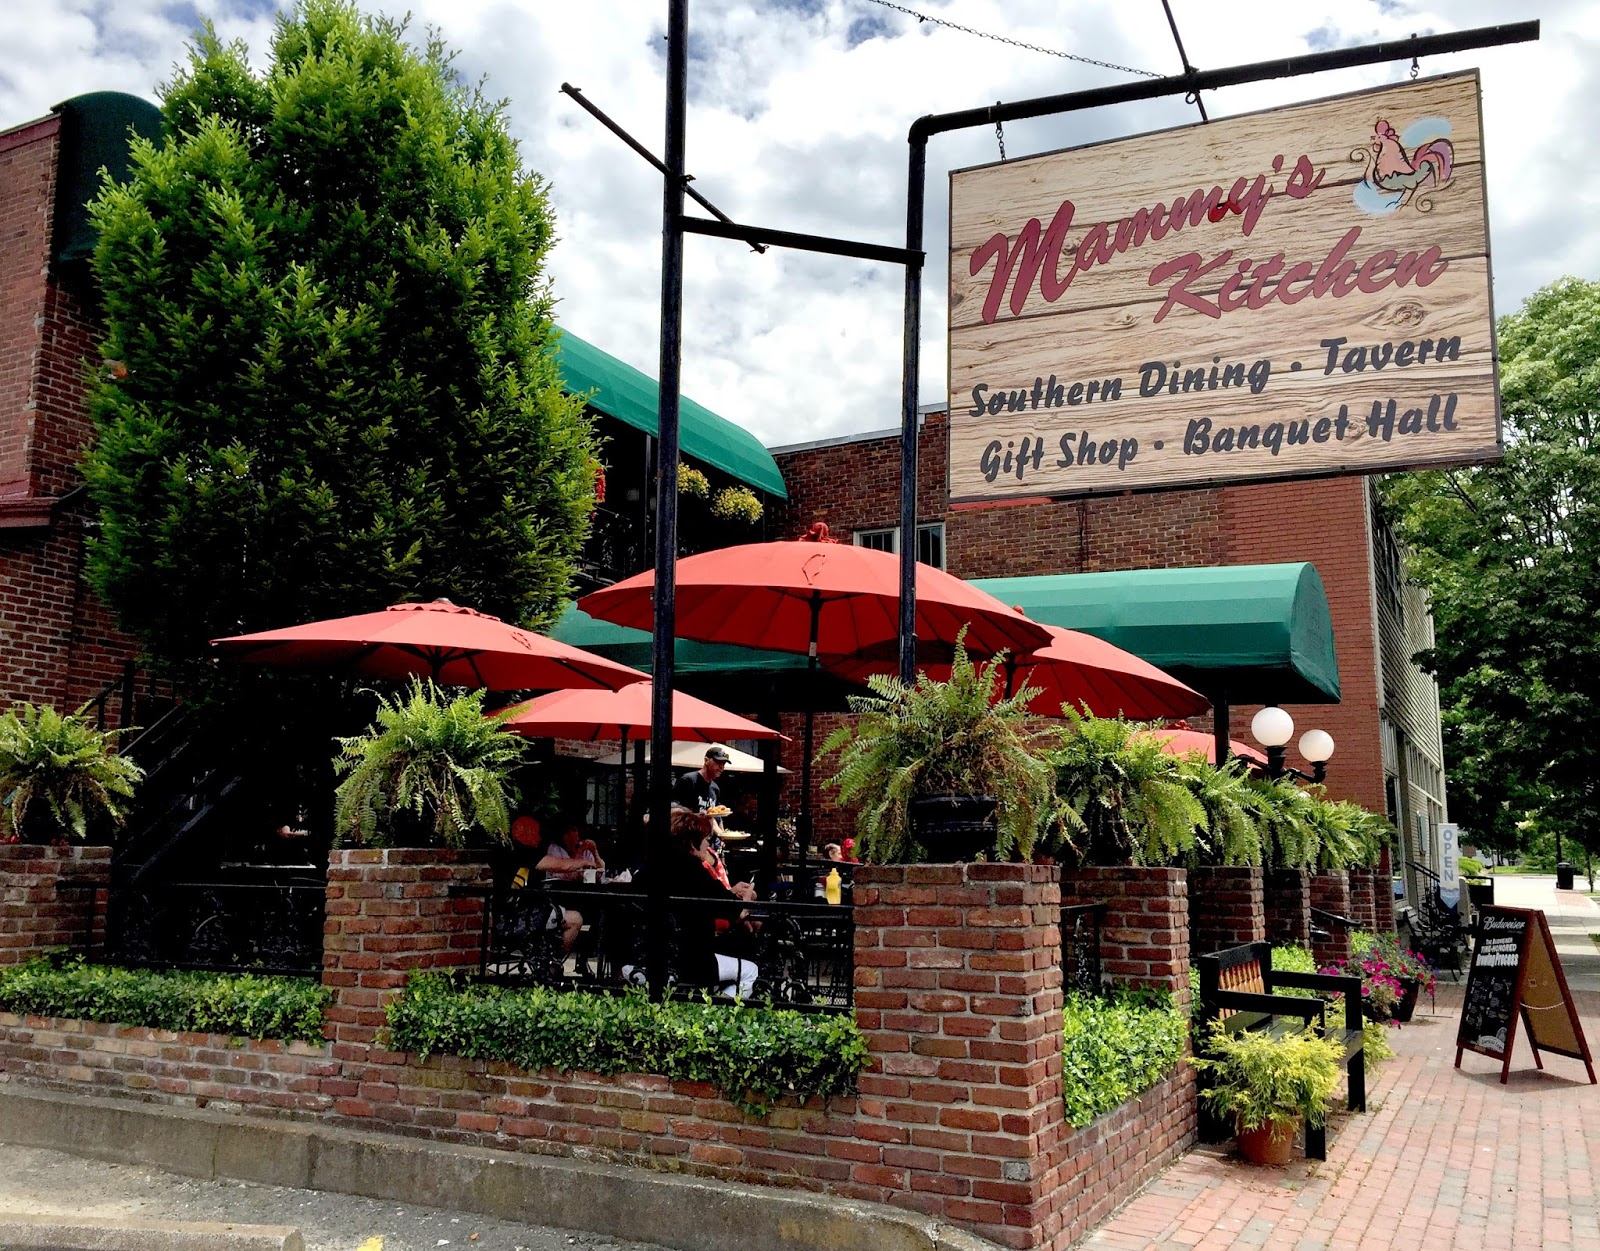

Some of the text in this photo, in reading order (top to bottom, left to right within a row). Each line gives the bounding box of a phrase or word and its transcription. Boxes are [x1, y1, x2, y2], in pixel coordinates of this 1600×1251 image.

[969, 153, 1327, 325] Mammy's
[1148, 225, 1450, 324] Kitchen
[969, 335, 1462, 418] Southern Dining Tavern
[980, 392, 1459, 483] Gift Shop Banquet Hall
[1443, 829, 1454, 882] OPEN
[1483, 916, 1526, 931] Budweiser
